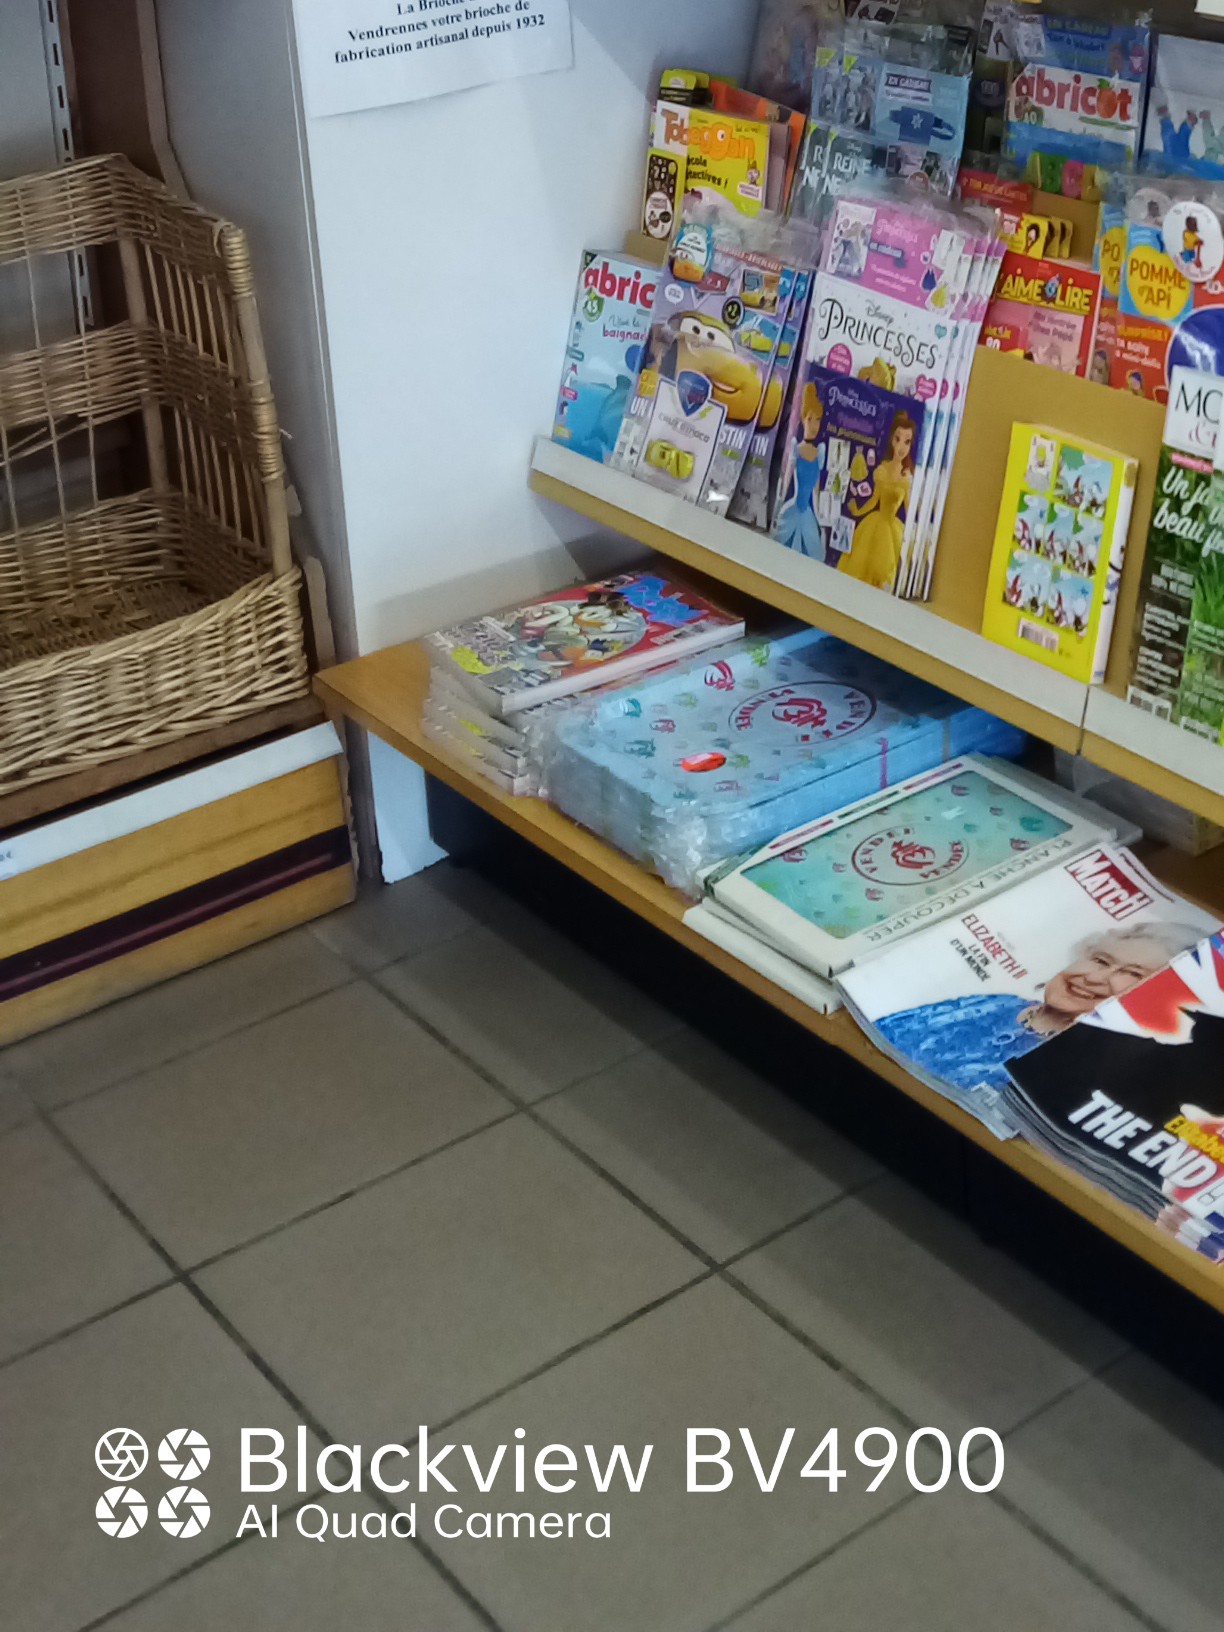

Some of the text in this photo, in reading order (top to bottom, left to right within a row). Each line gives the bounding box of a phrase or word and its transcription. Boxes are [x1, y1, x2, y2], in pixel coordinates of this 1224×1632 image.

[348, 0, 530, 42] Vendrennes votre brioche de
[397, 2, 414, 15] La
[335, 14, 545, 63] fabrication artisanal depuis 1932
[1129, 259, 1187, 290] POMME
[1066, 854, 1154, 921] MATCH
[961, 913, 1022, 977] ELIZABETH
[1068, 1091, 1219, 1189] THE END
